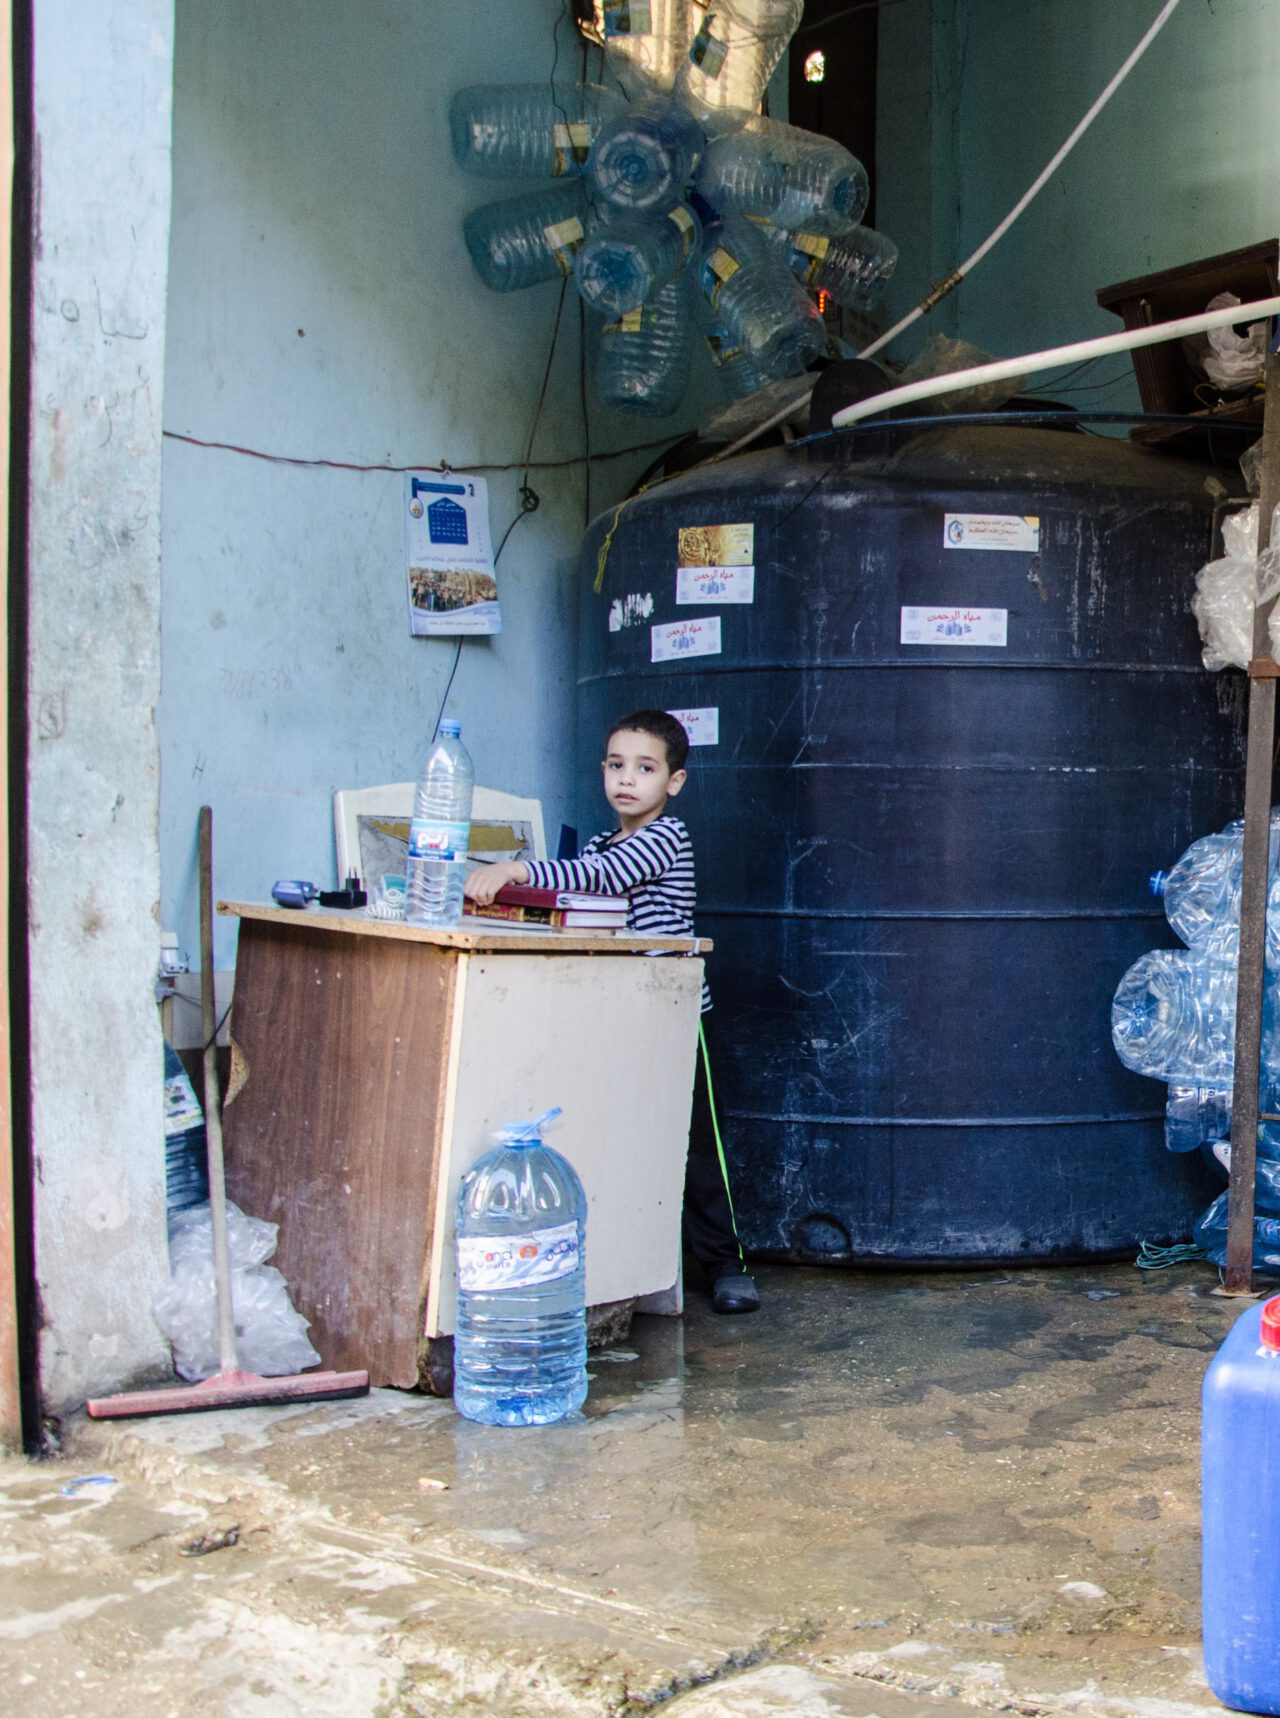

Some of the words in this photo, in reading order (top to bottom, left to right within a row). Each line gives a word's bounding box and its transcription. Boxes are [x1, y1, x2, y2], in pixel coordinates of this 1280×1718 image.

[693, 568, 718, 582] الرحمن
[720, 568, 734, 580] مياه
[927, 610, 960, 622] الرحمن
[963, 610, 981, 621] مياه
[665, 623, 688, 639] الرحمن
[688, 623, 702, 634] مياه
[417, 831, 449, 850] ريم
